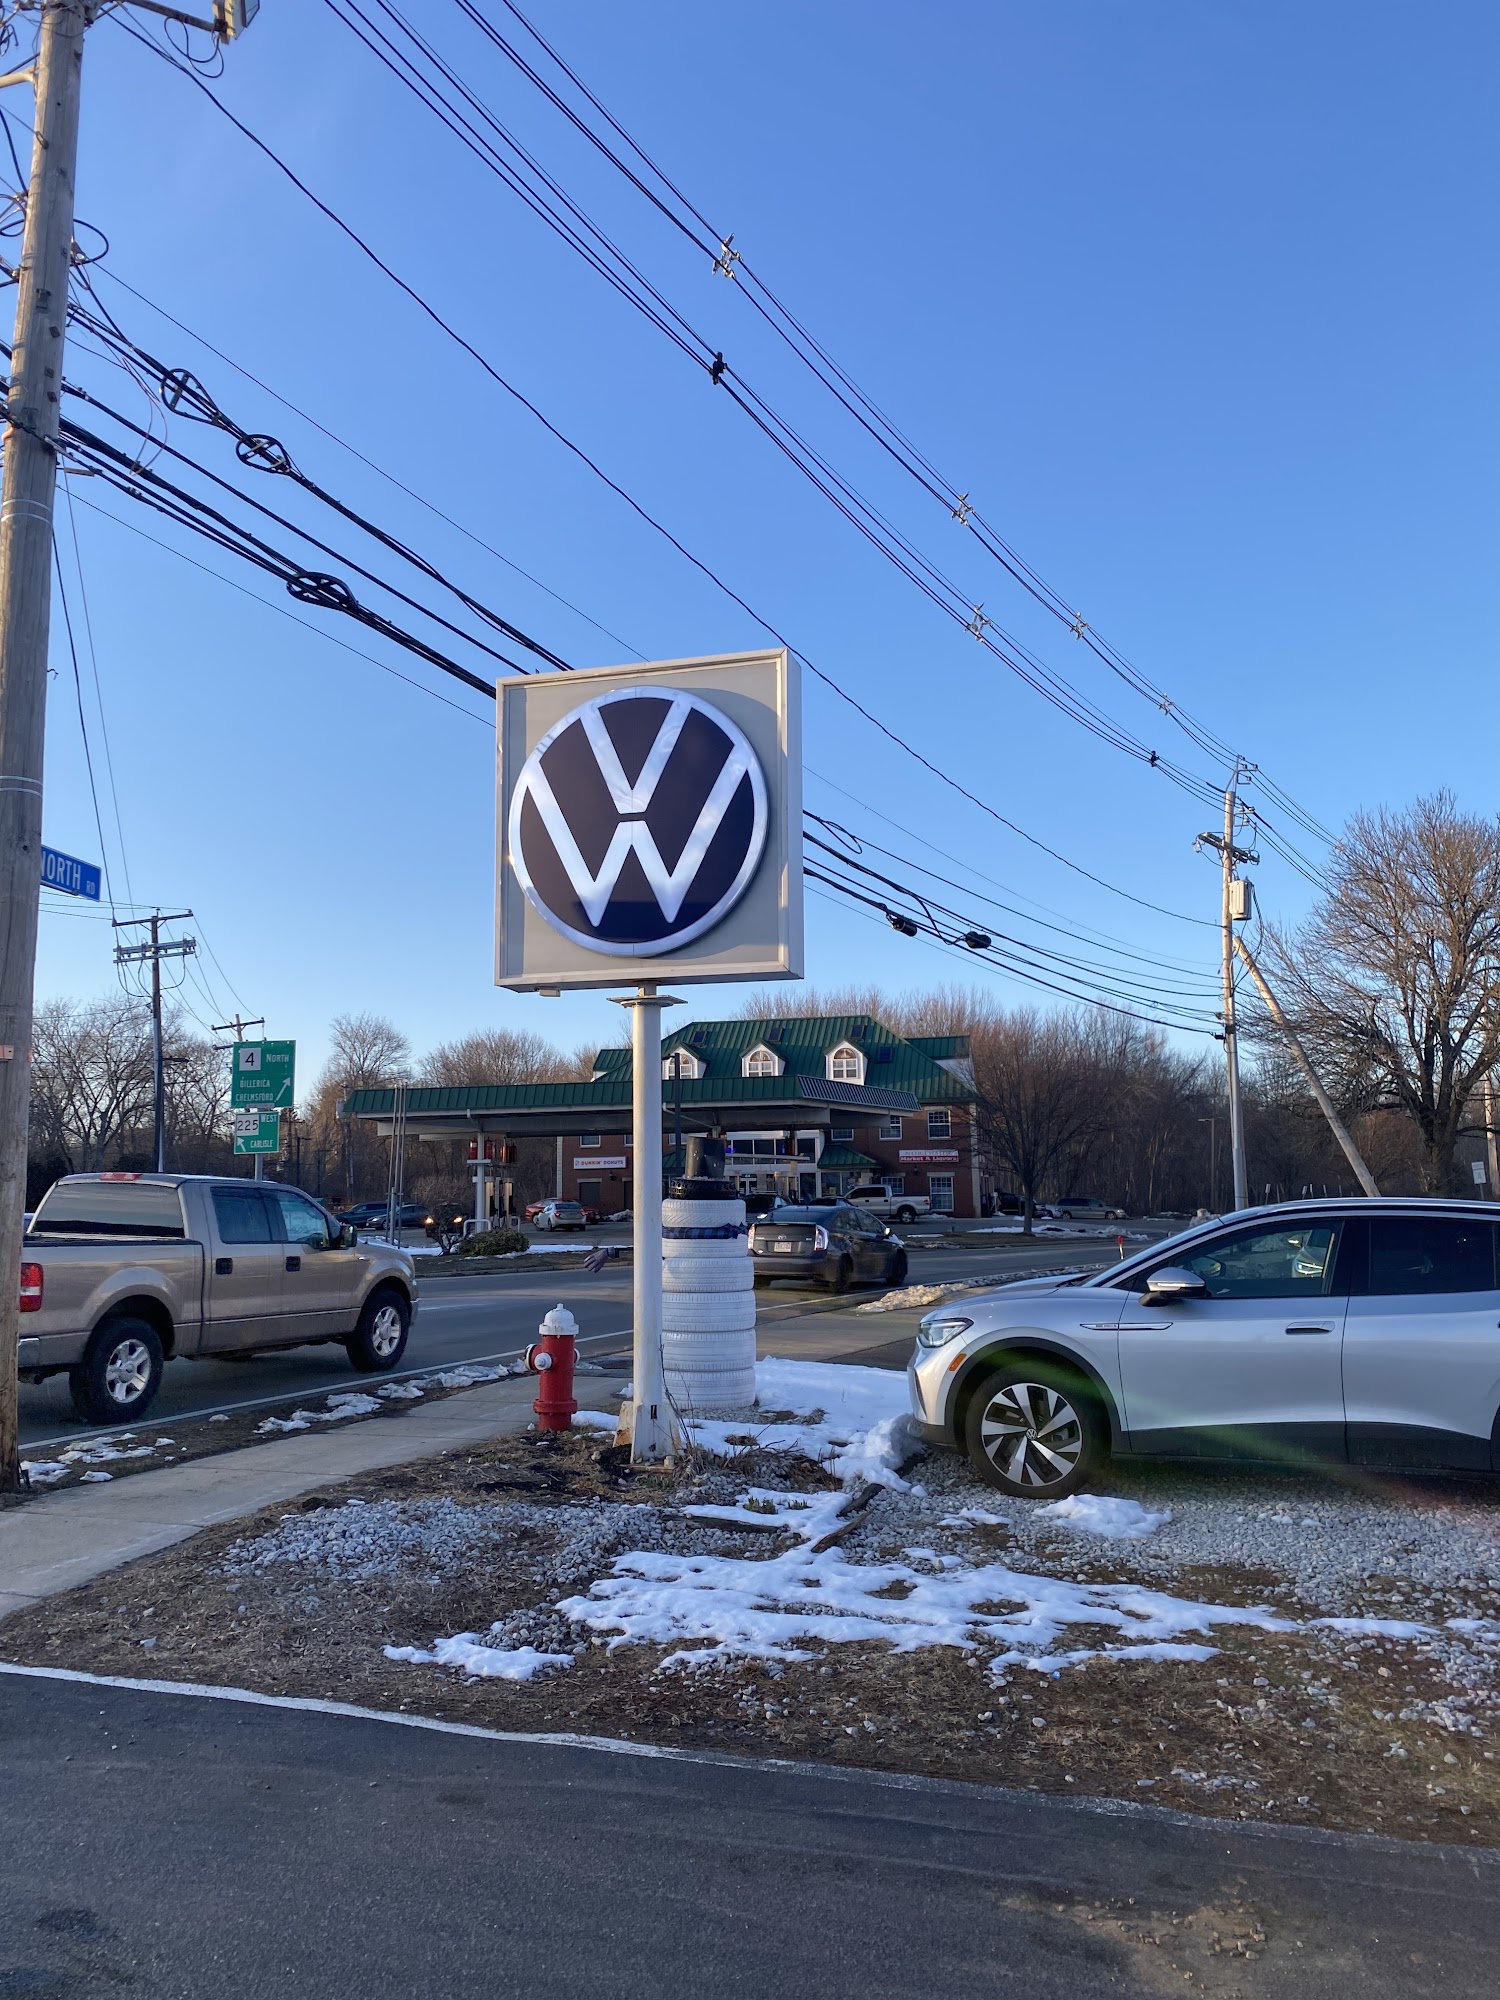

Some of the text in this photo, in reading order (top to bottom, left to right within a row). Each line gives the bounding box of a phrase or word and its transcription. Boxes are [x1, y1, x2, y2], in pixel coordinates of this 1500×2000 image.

[518, 692, 757, 931] VW
[86, 880, 95, 895] RD
[245, 1052, 289, 1067] 4 NORTH
[240, 1079, 271, 1088] BILLERICA
[235, 1093, 274, 1102] CHELMSFORD
[237, 1113, 278, 1131] 225 WEST
[250, 1139, 274, 1149] CARLISLE
